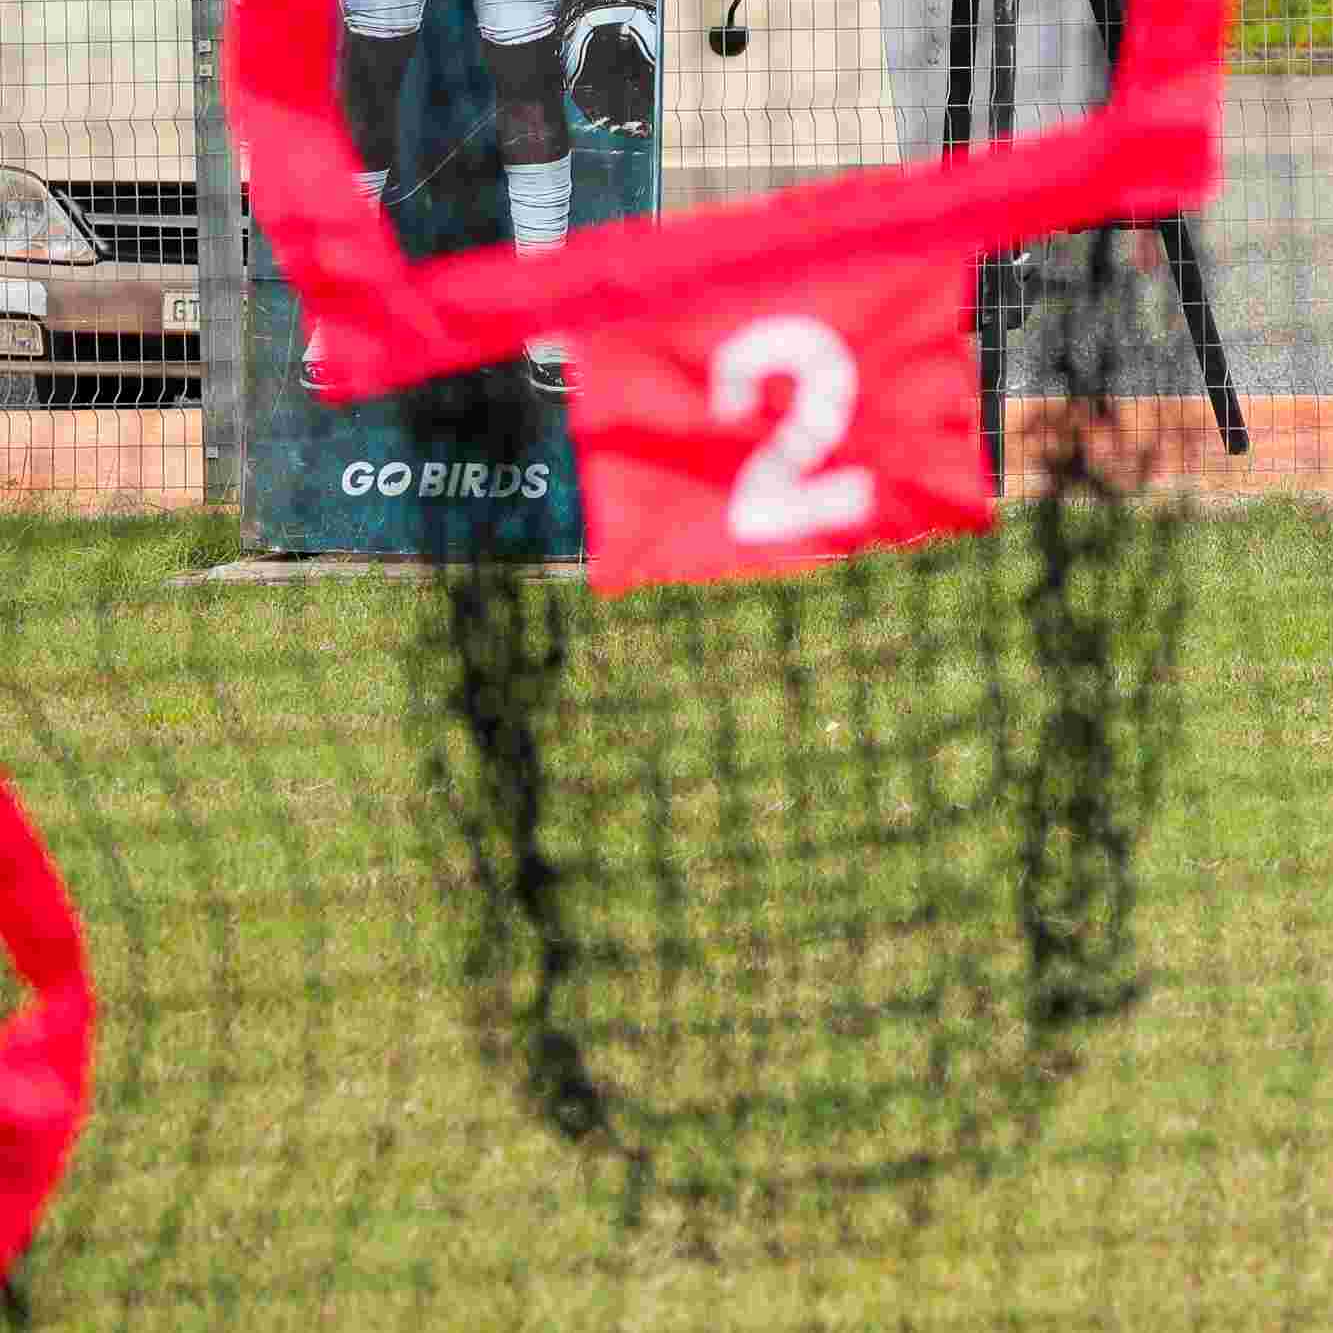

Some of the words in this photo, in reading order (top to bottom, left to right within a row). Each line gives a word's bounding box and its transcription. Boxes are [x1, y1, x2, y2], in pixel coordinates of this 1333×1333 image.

[341, 461, 412, 497] GO
[418, 462, 551, 498] BIRDS
[709, 313, 878, 545] 2
